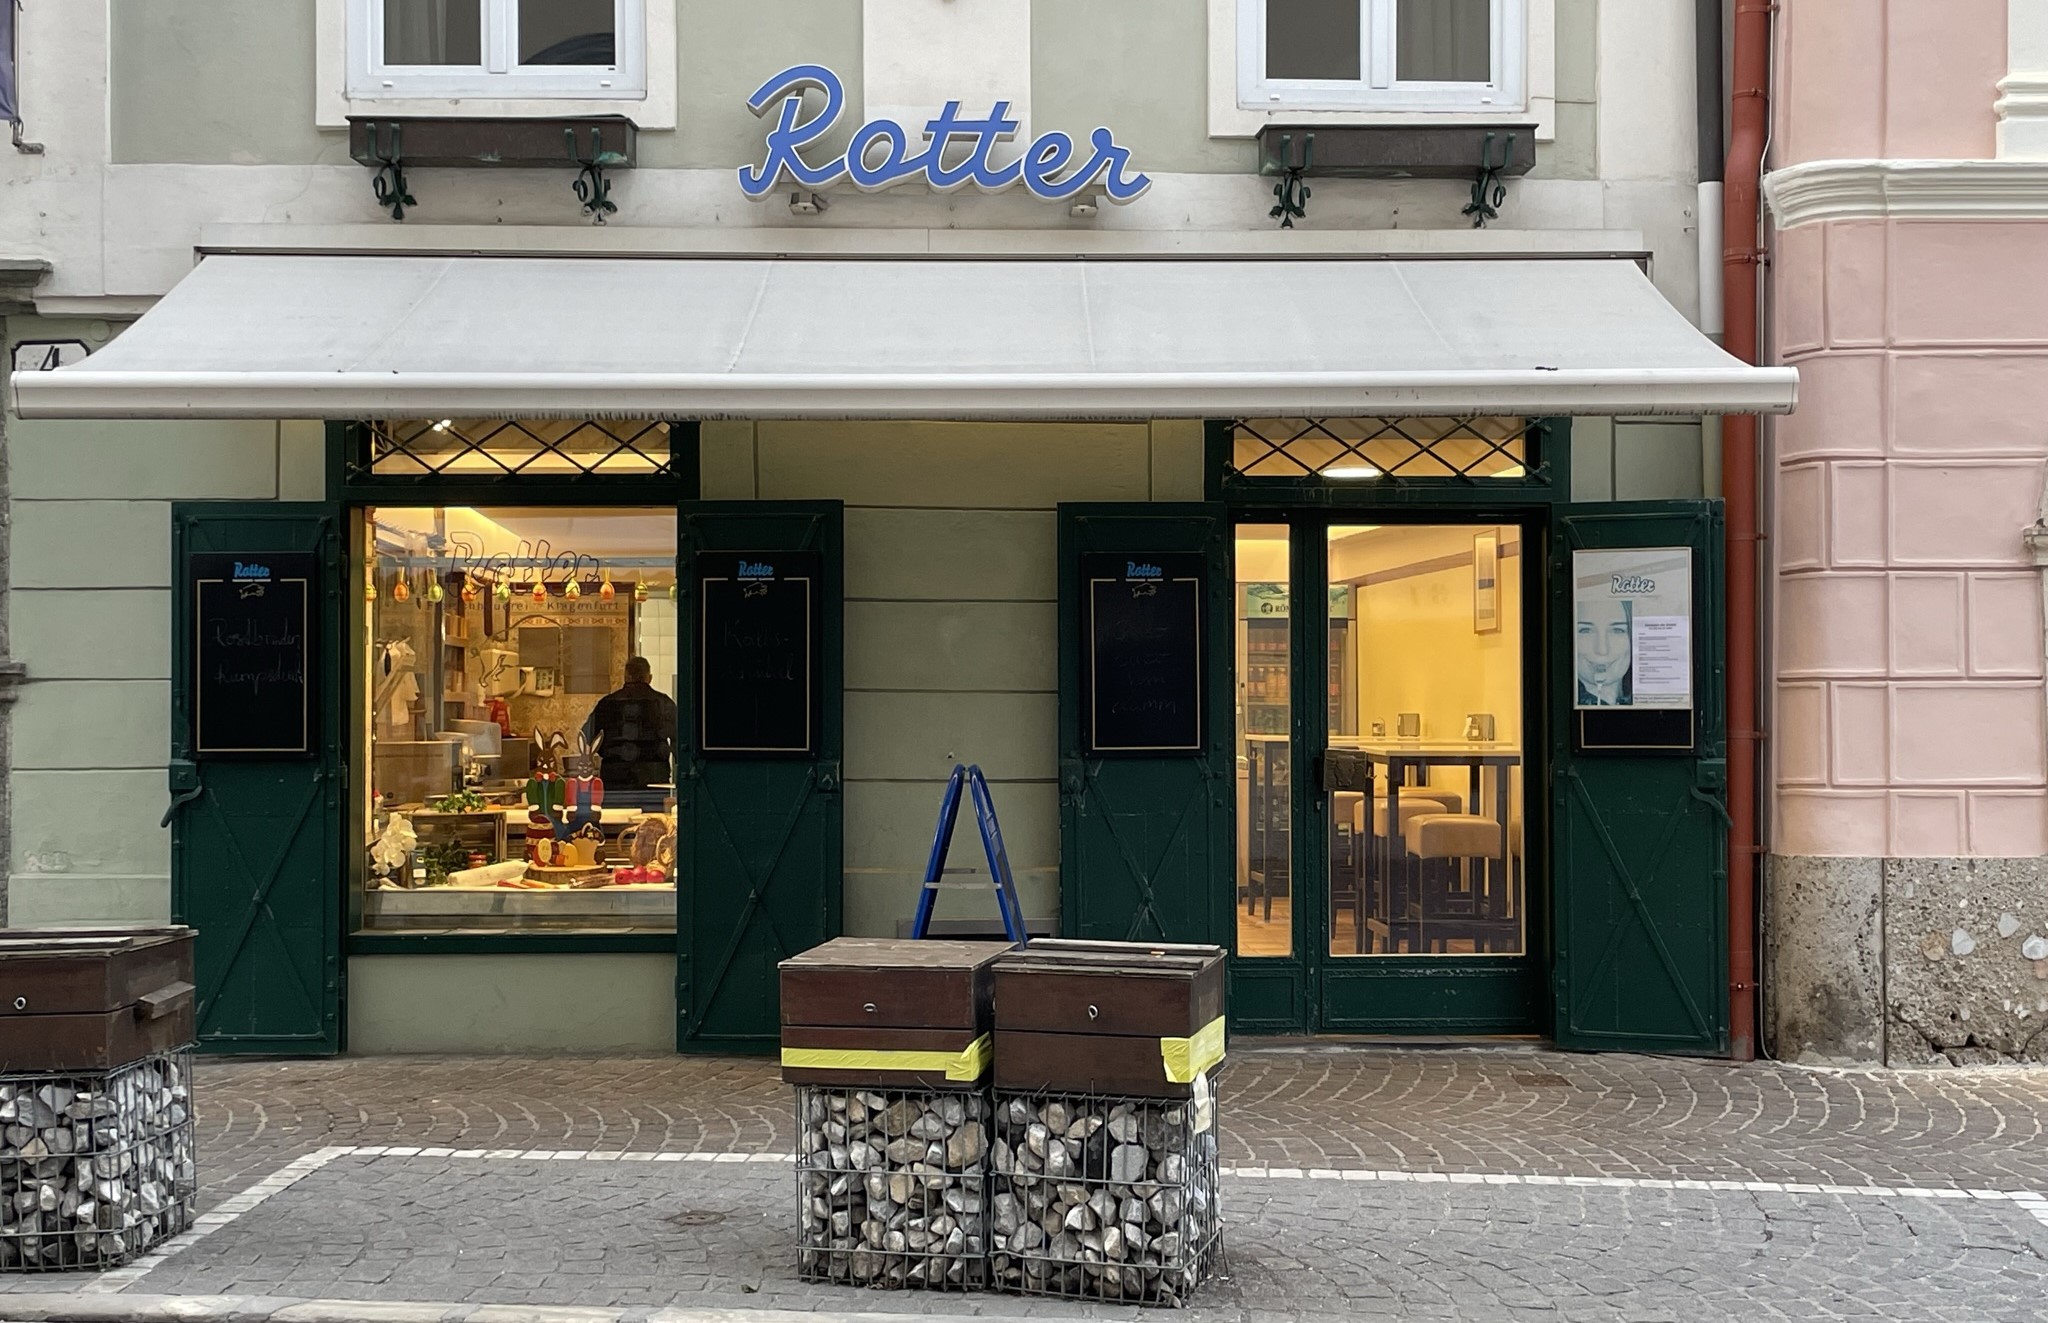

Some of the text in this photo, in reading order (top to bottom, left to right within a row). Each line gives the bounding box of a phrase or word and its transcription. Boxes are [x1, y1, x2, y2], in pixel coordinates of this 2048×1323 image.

[739, 63, 1153, 205] Rotter
[234, 561, 271, 578] Rotter
[449, 531, 600, 598] Rotter
[738, 560, 774, 577] Rotter
[1127, 561, 1162, 577] Rotter
[1611, 574, 1655, 594] Rotter
